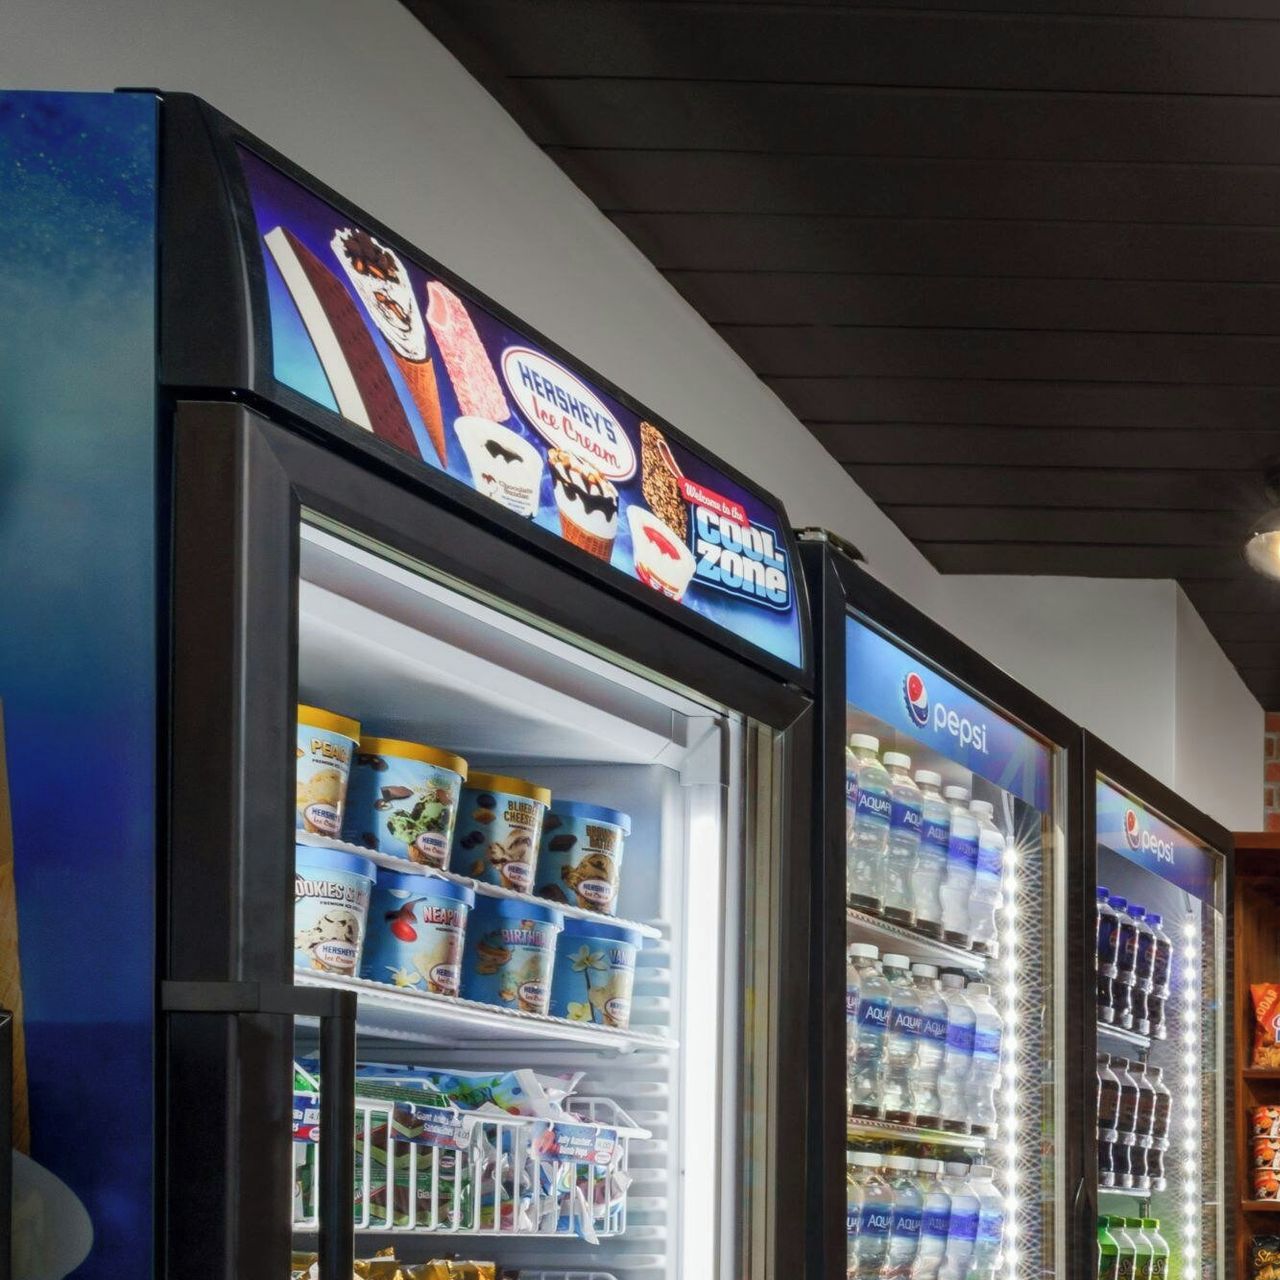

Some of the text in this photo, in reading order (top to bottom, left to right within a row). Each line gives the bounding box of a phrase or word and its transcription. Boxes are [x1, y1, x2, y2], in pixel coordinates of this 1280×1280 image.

[517, 360, 618, 446] HERSHEY'S
[530, 394, 621, 470] Ice Cream
[684, 482, 744, 522] Welcome to the
[695, 505, 785, 572] COOL
[933, 702, 988, 754] pepsi
[1141, 829, 1176, 865] pepsi
[295, 880, 345, 901] OOKIES
